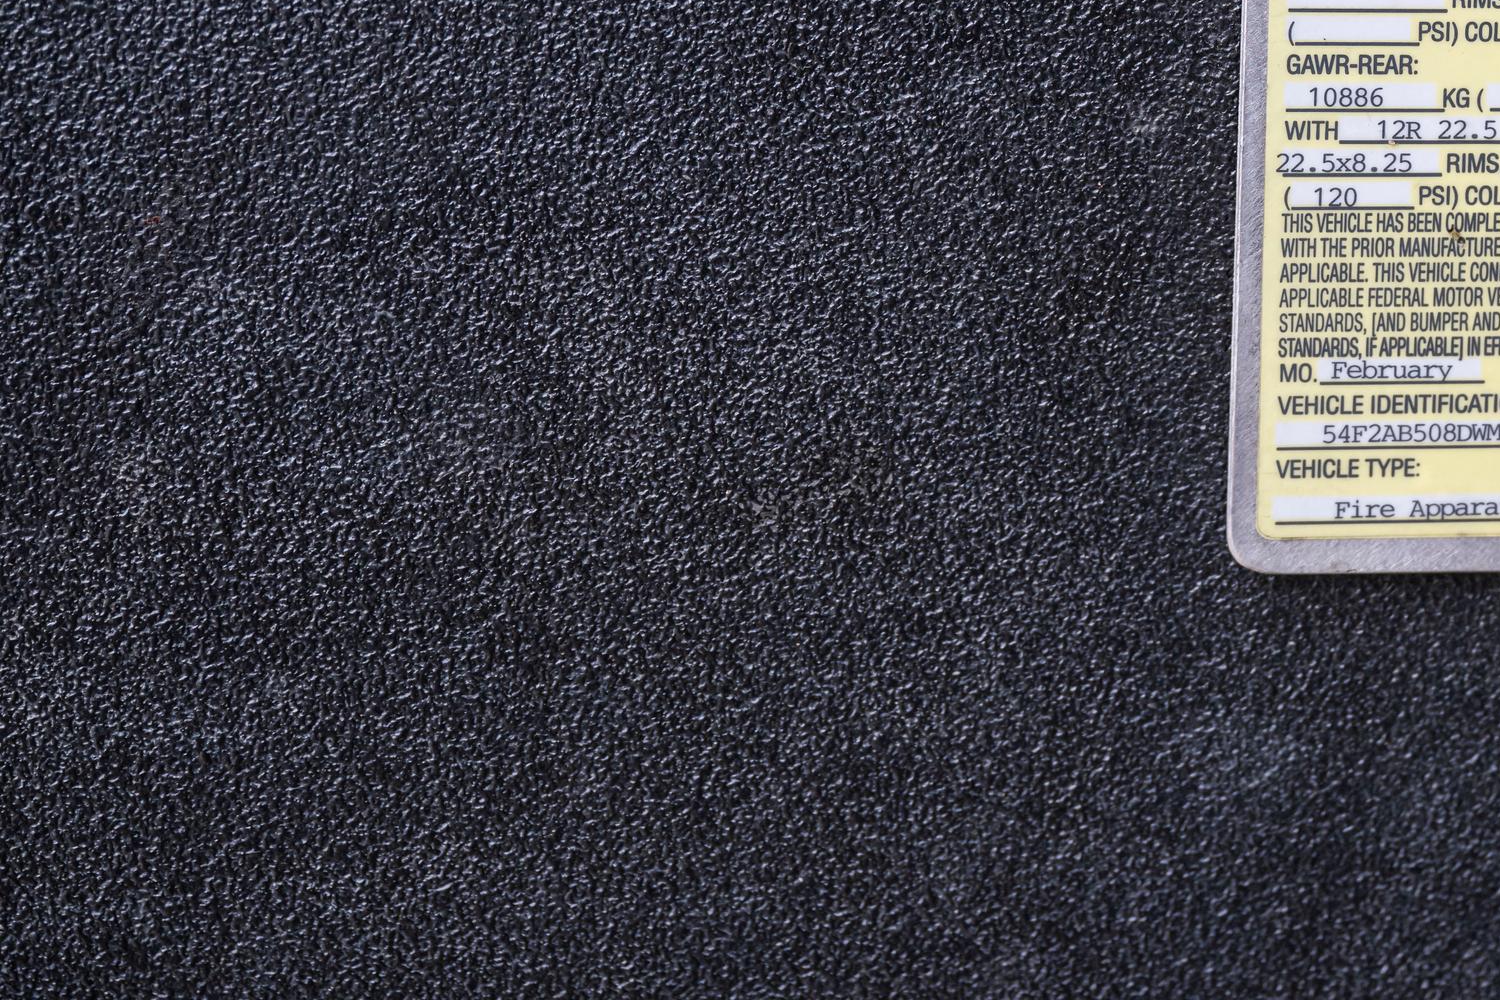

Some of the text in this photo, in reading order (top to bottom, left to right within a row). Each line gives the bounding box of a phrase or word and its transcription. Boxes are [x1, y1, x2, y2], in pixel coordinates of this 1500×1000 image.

[1418, 22, 1458, 46] PSI)
[1287, 56, 1418, 75] GAWR-REAR:
[1309, 87, 1384, 107] 10886
[1443, 89, 1470, 109] KG
[1285, 121, 1338, 141] WITH
[1378, 120, 1421, 140] 12R
[1439, 120, 1497, 140] 22.5
[1277, 153, 1412, 173] 22.5x8.25
[1314, 187, 1357, 207] 120
[1419, 186, 1458, 210] PSI)
[1282, 213, 1312, 232] THIS
[1317, 213, 1372, 232] VEHICLE
[1377, 213, 1403, 232] HAS
[1408, 213, 1441, 232] BEEN
[1281, 238, 1316, 257] WITH
[1321, 238, 1347, 257] THE
[1352, 238, 1394, 257] PRIOR
[1280, 263, 1368, 283] APPLICABLE.
[1373, 263, 1404, 282] THIS
[1409, 262, 1466, 282] VEHICLE
[1279, 288, 1364, 307] APPLICABLE
[1368, 288, 1428, 307] FEDERAL
[1433, 287, 1483, 307] MOTOR
[1279, 313, 1366, 334] STANDARDS,
[1373, 312, 1406, 336] [AND
[1411, 312, 1468, 331] BUMPER
[1472, 312, 1500, 331] AND
[1278, 338, 1362, 359] STANDARDS,
[1366, 337, 1377, 356] IF
[1379, 337, 1464, 360] APPLICABLE]
[1467, 337, 1480, 355] IN
[1280, 363, 1317, 383] MO.
[1331, 361, 1453, 381] February
[1278, 396, 1365, 414] VEHICLE
[1276, 459, 1420, 478] VEHICLE TYPE:
[1335, 501, 1395, 519] Fire
